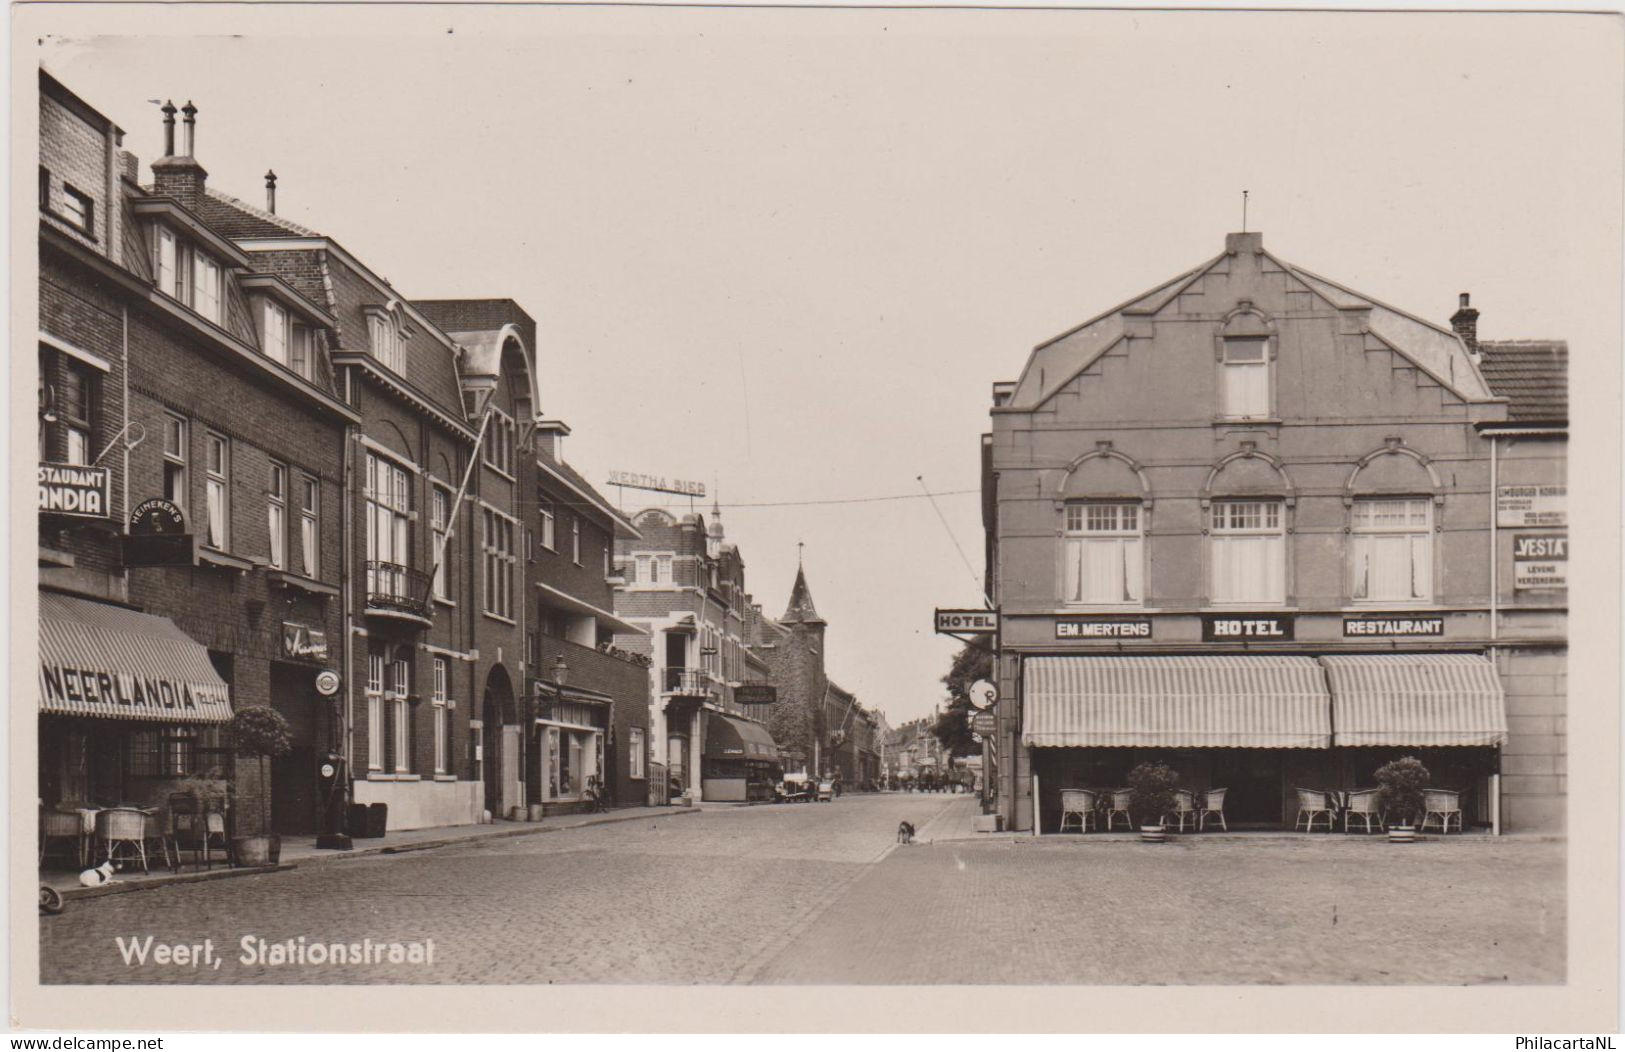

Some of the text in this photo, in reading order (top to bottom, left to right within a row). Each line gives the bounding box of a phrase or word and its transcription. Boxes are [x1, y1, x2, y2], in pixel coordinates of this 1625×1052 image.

[674, 479, 706, 495] BIER
[939, 615, 995, 627] HOTEL
[1213, 620, 1284, 636] HOTEL
[1346, 619, 1442, 635] RESTAURANT
[1083, 623, 1150, 637] MERTENS
[42, 664, 197, 711] NEERLANDIA
